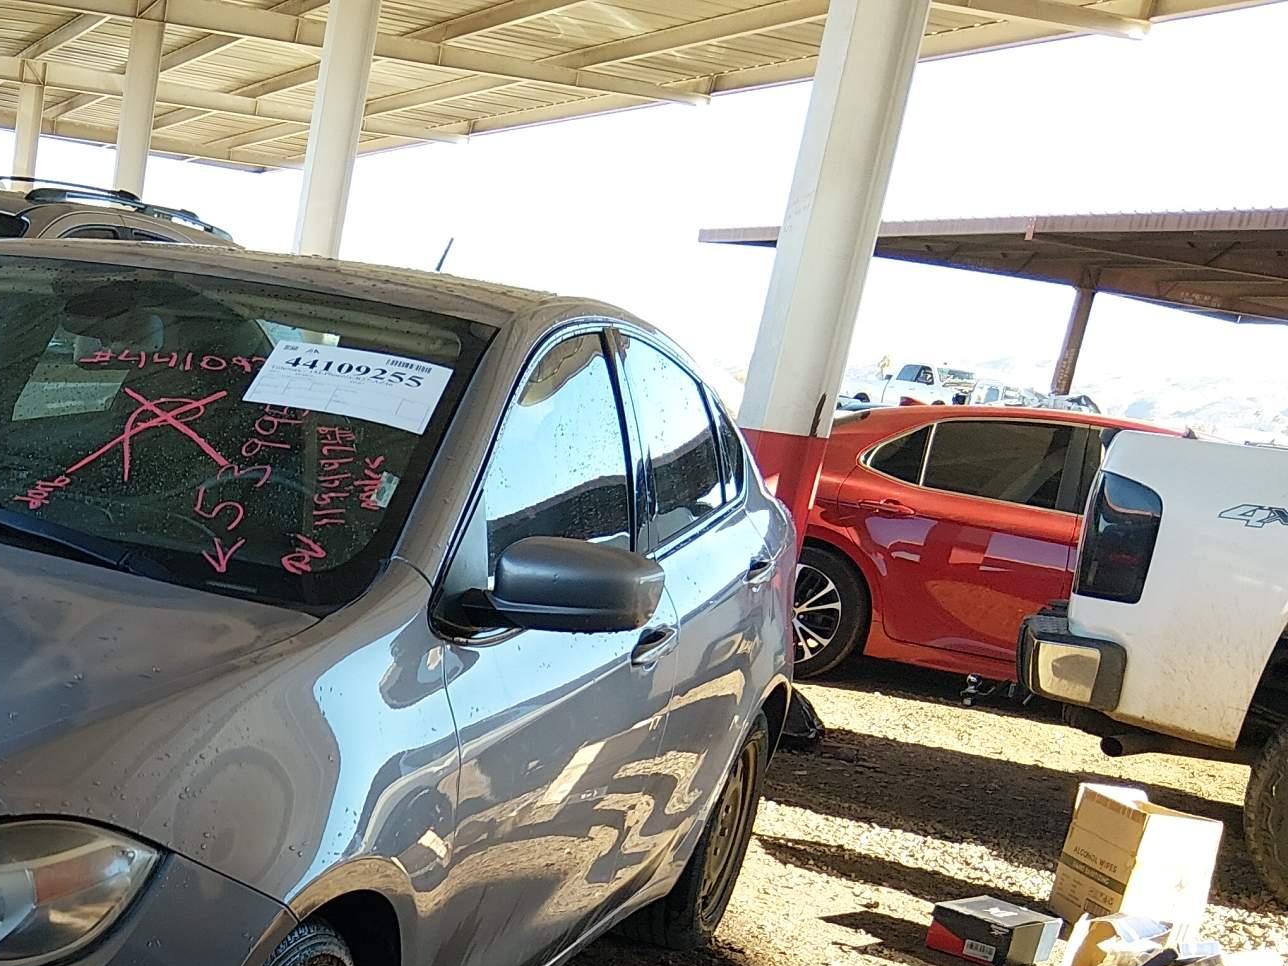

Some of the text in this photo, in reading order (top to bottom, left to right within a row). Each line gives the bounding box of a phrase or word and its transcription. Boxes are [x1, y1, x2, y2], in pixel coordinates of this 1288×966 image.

[79, 348, 266, 373] #44109
[284, 356, 424, 389] 44109255
[1073, 846, 1117, 873] ALCOHOL WIPES
